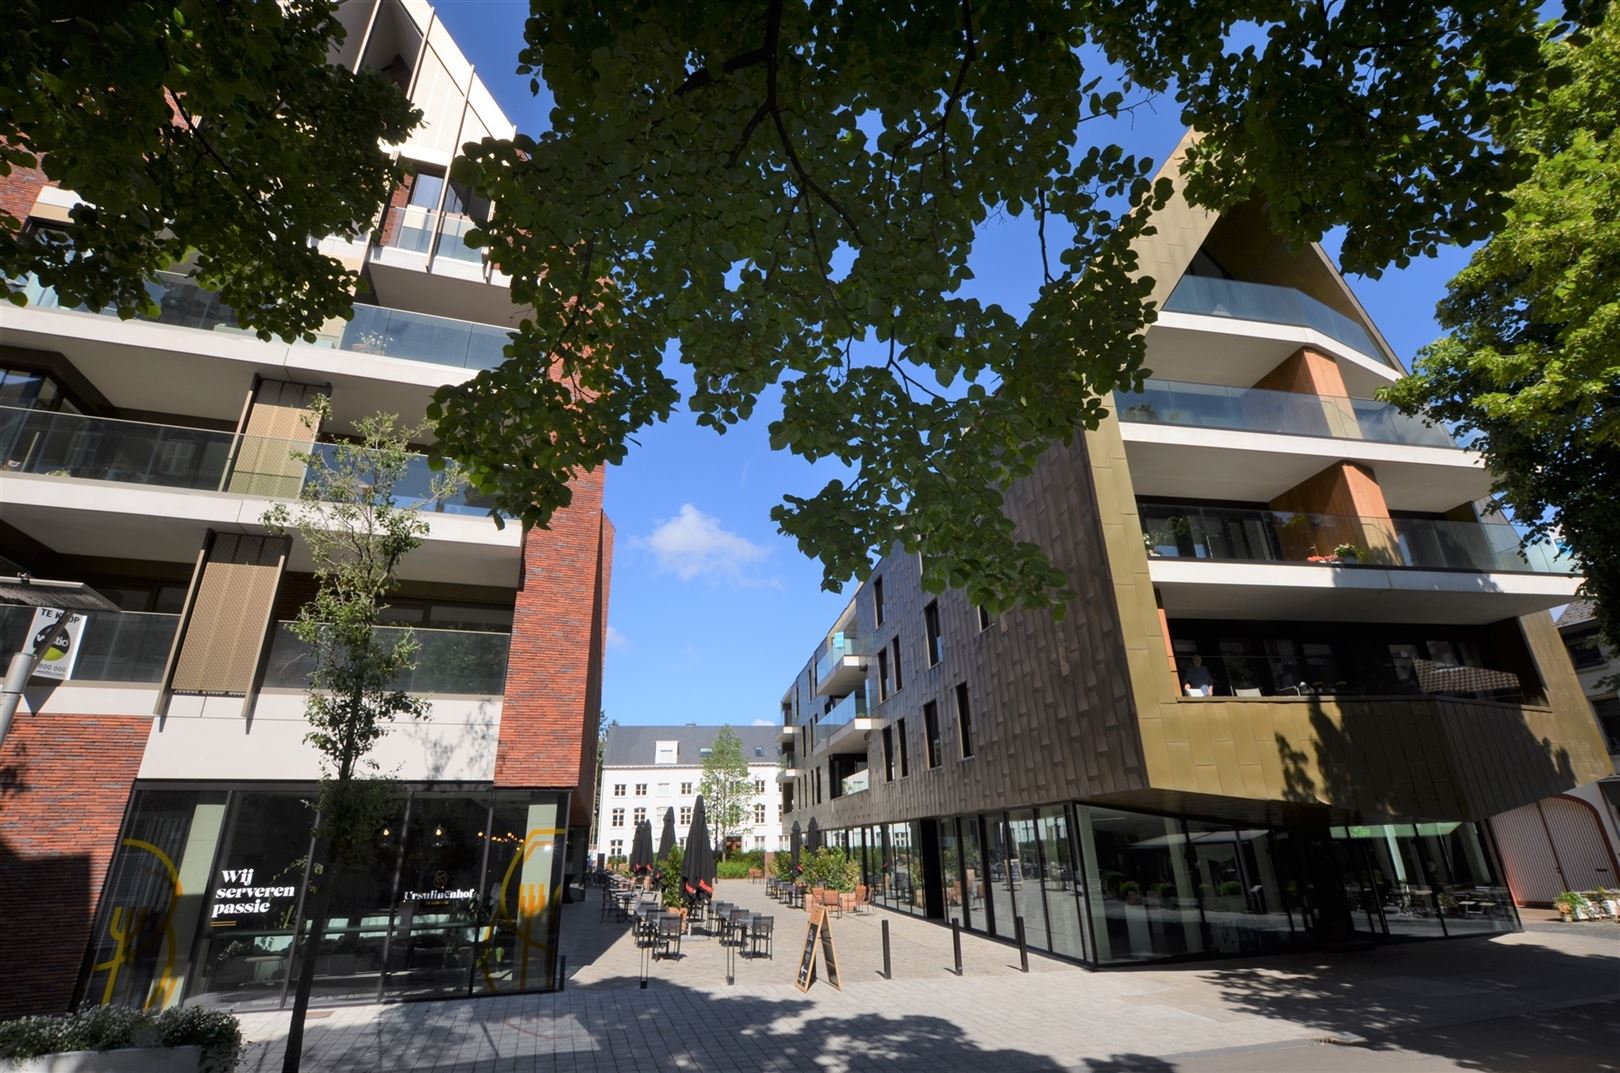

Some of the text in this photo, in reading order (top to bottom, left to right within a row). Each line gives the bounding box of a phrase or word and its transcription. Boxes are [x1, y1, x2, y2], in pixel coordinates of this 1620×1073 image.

[41, 608, 80, 624] TE KOP
[221, 868, 254, 886] Wij
[215, 886, 295, 898] serveren
[403, 888, 475, 900] Ursulinenhof
[211, 898, 271, 918] passie
